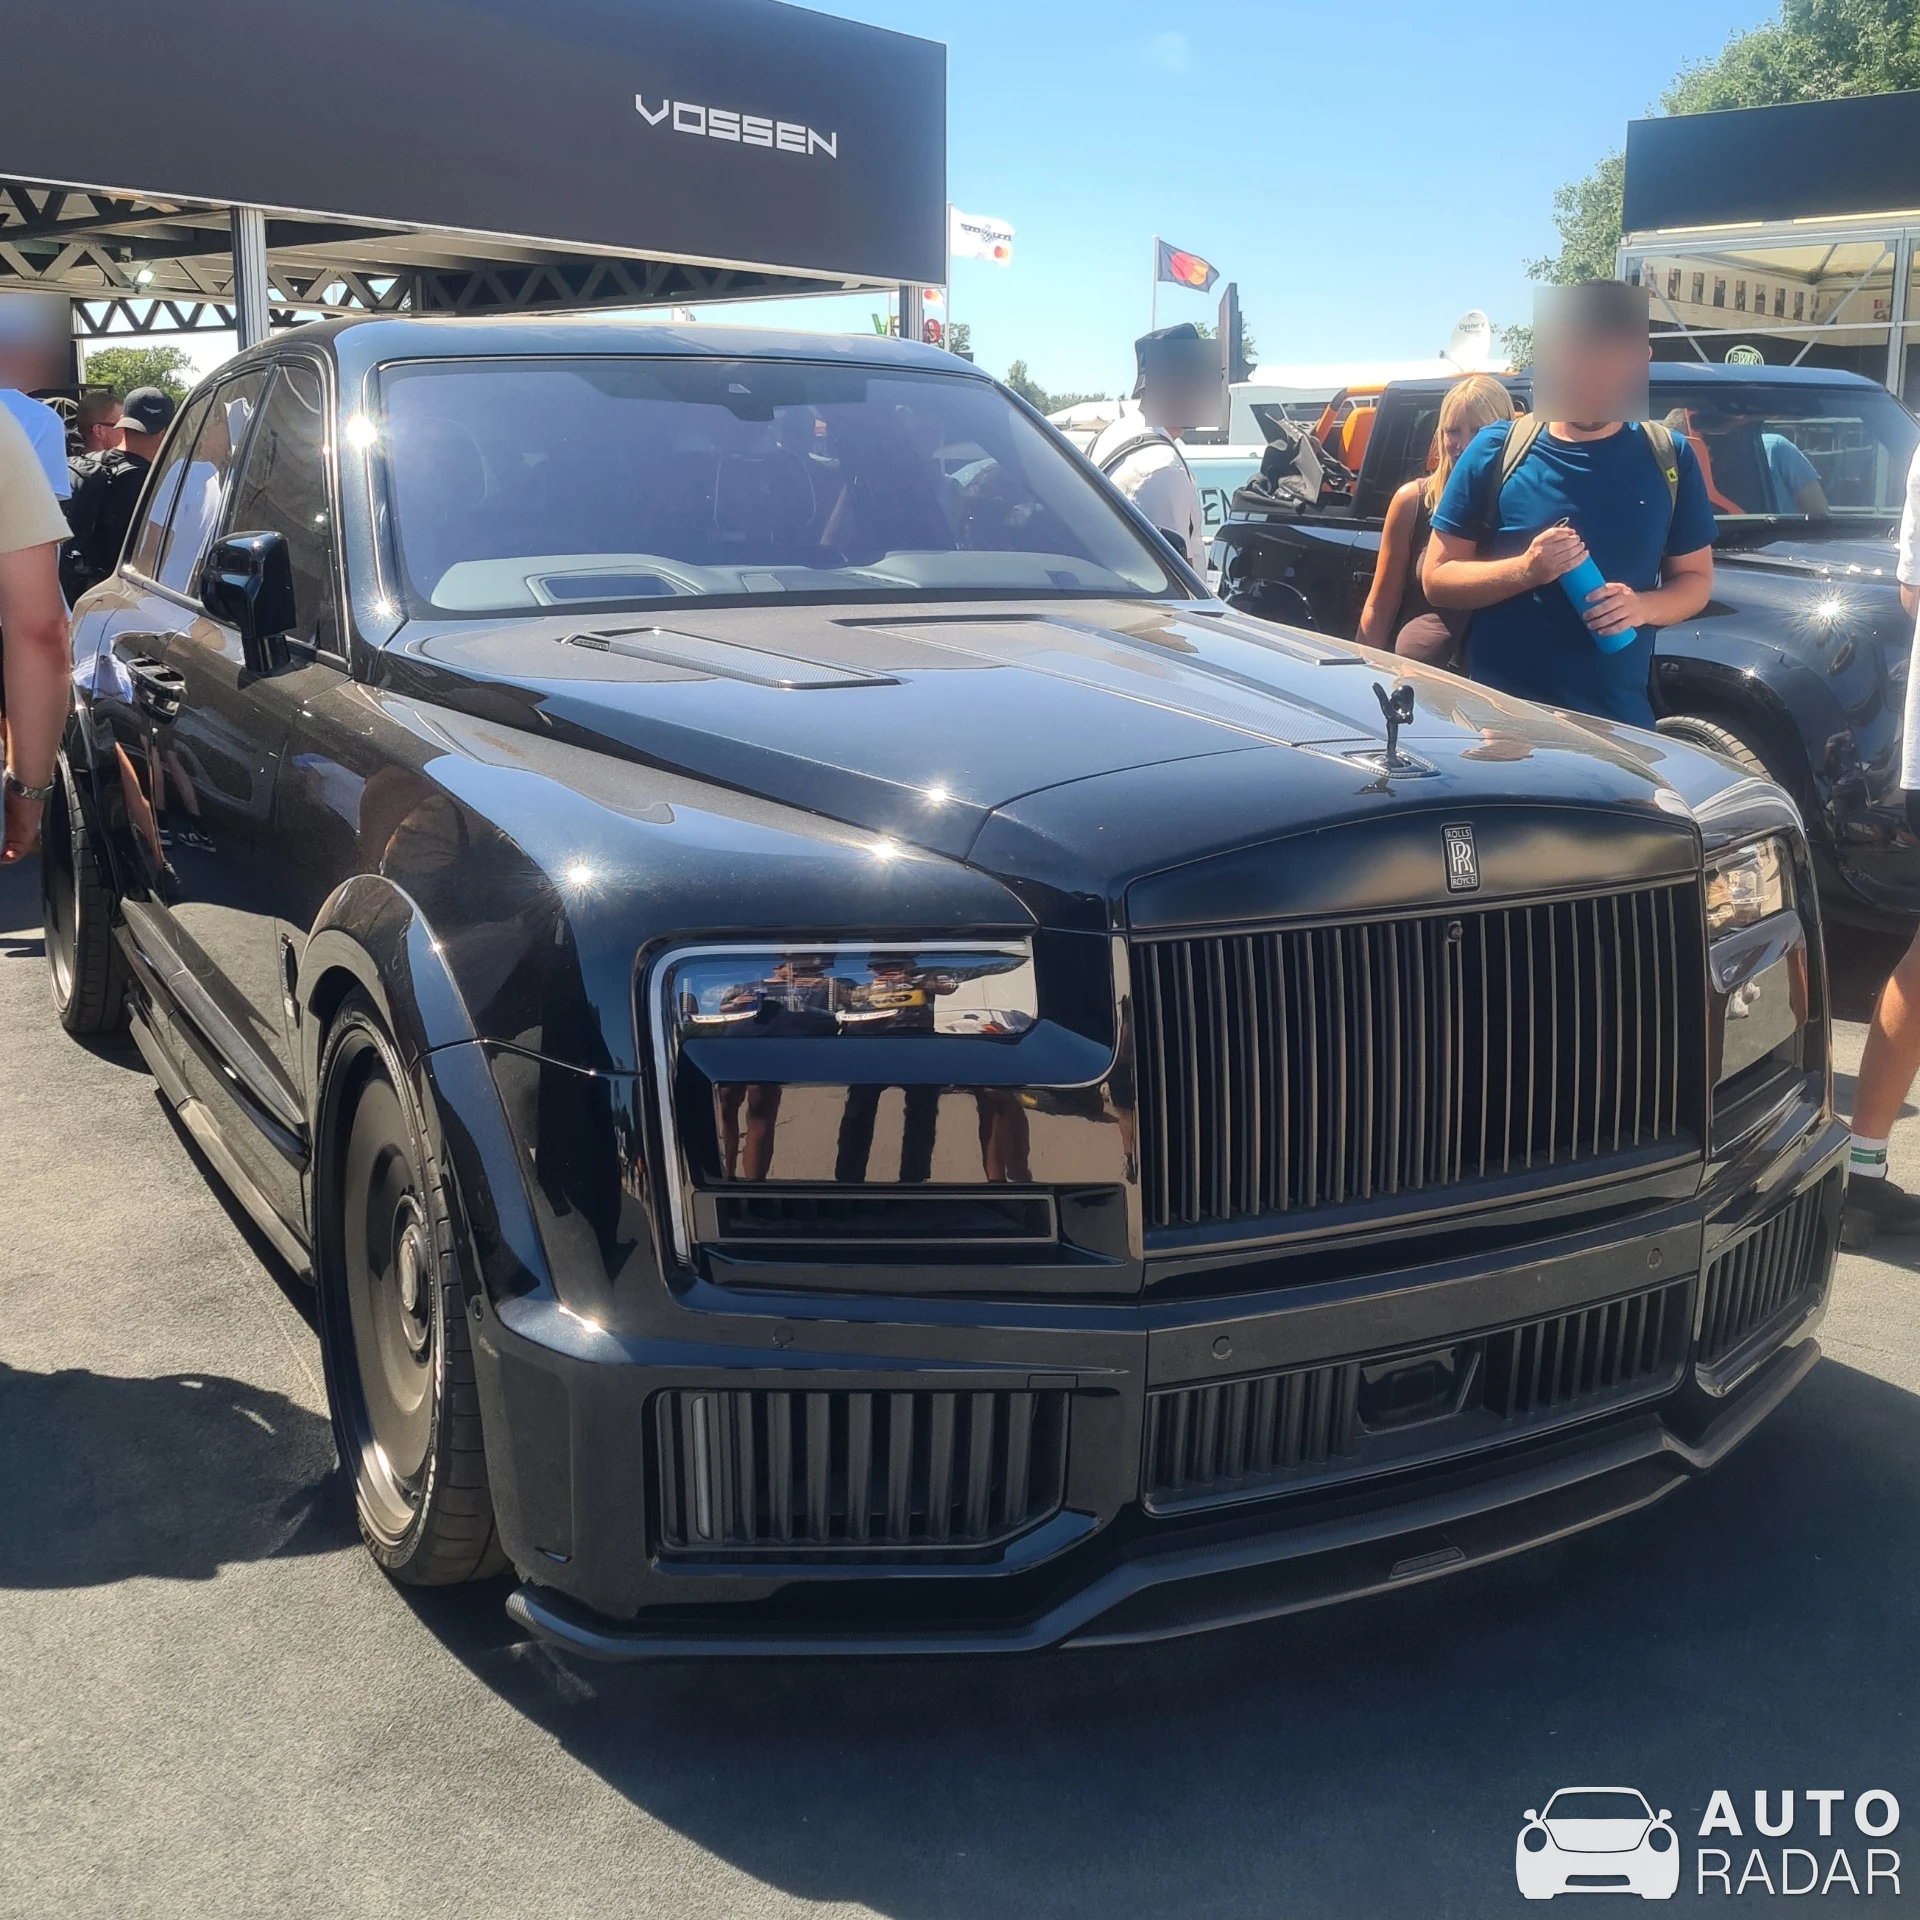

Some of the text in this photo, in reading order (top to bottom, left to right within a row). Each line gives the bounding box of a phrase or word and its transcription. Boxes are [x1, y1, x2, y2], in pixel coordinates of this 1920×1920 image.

[635, 94, 837, 159] VOSSEN
[1447, 829, 1470, 838] ROLLS
[1452, 877, 1475, 885] ROYCE
